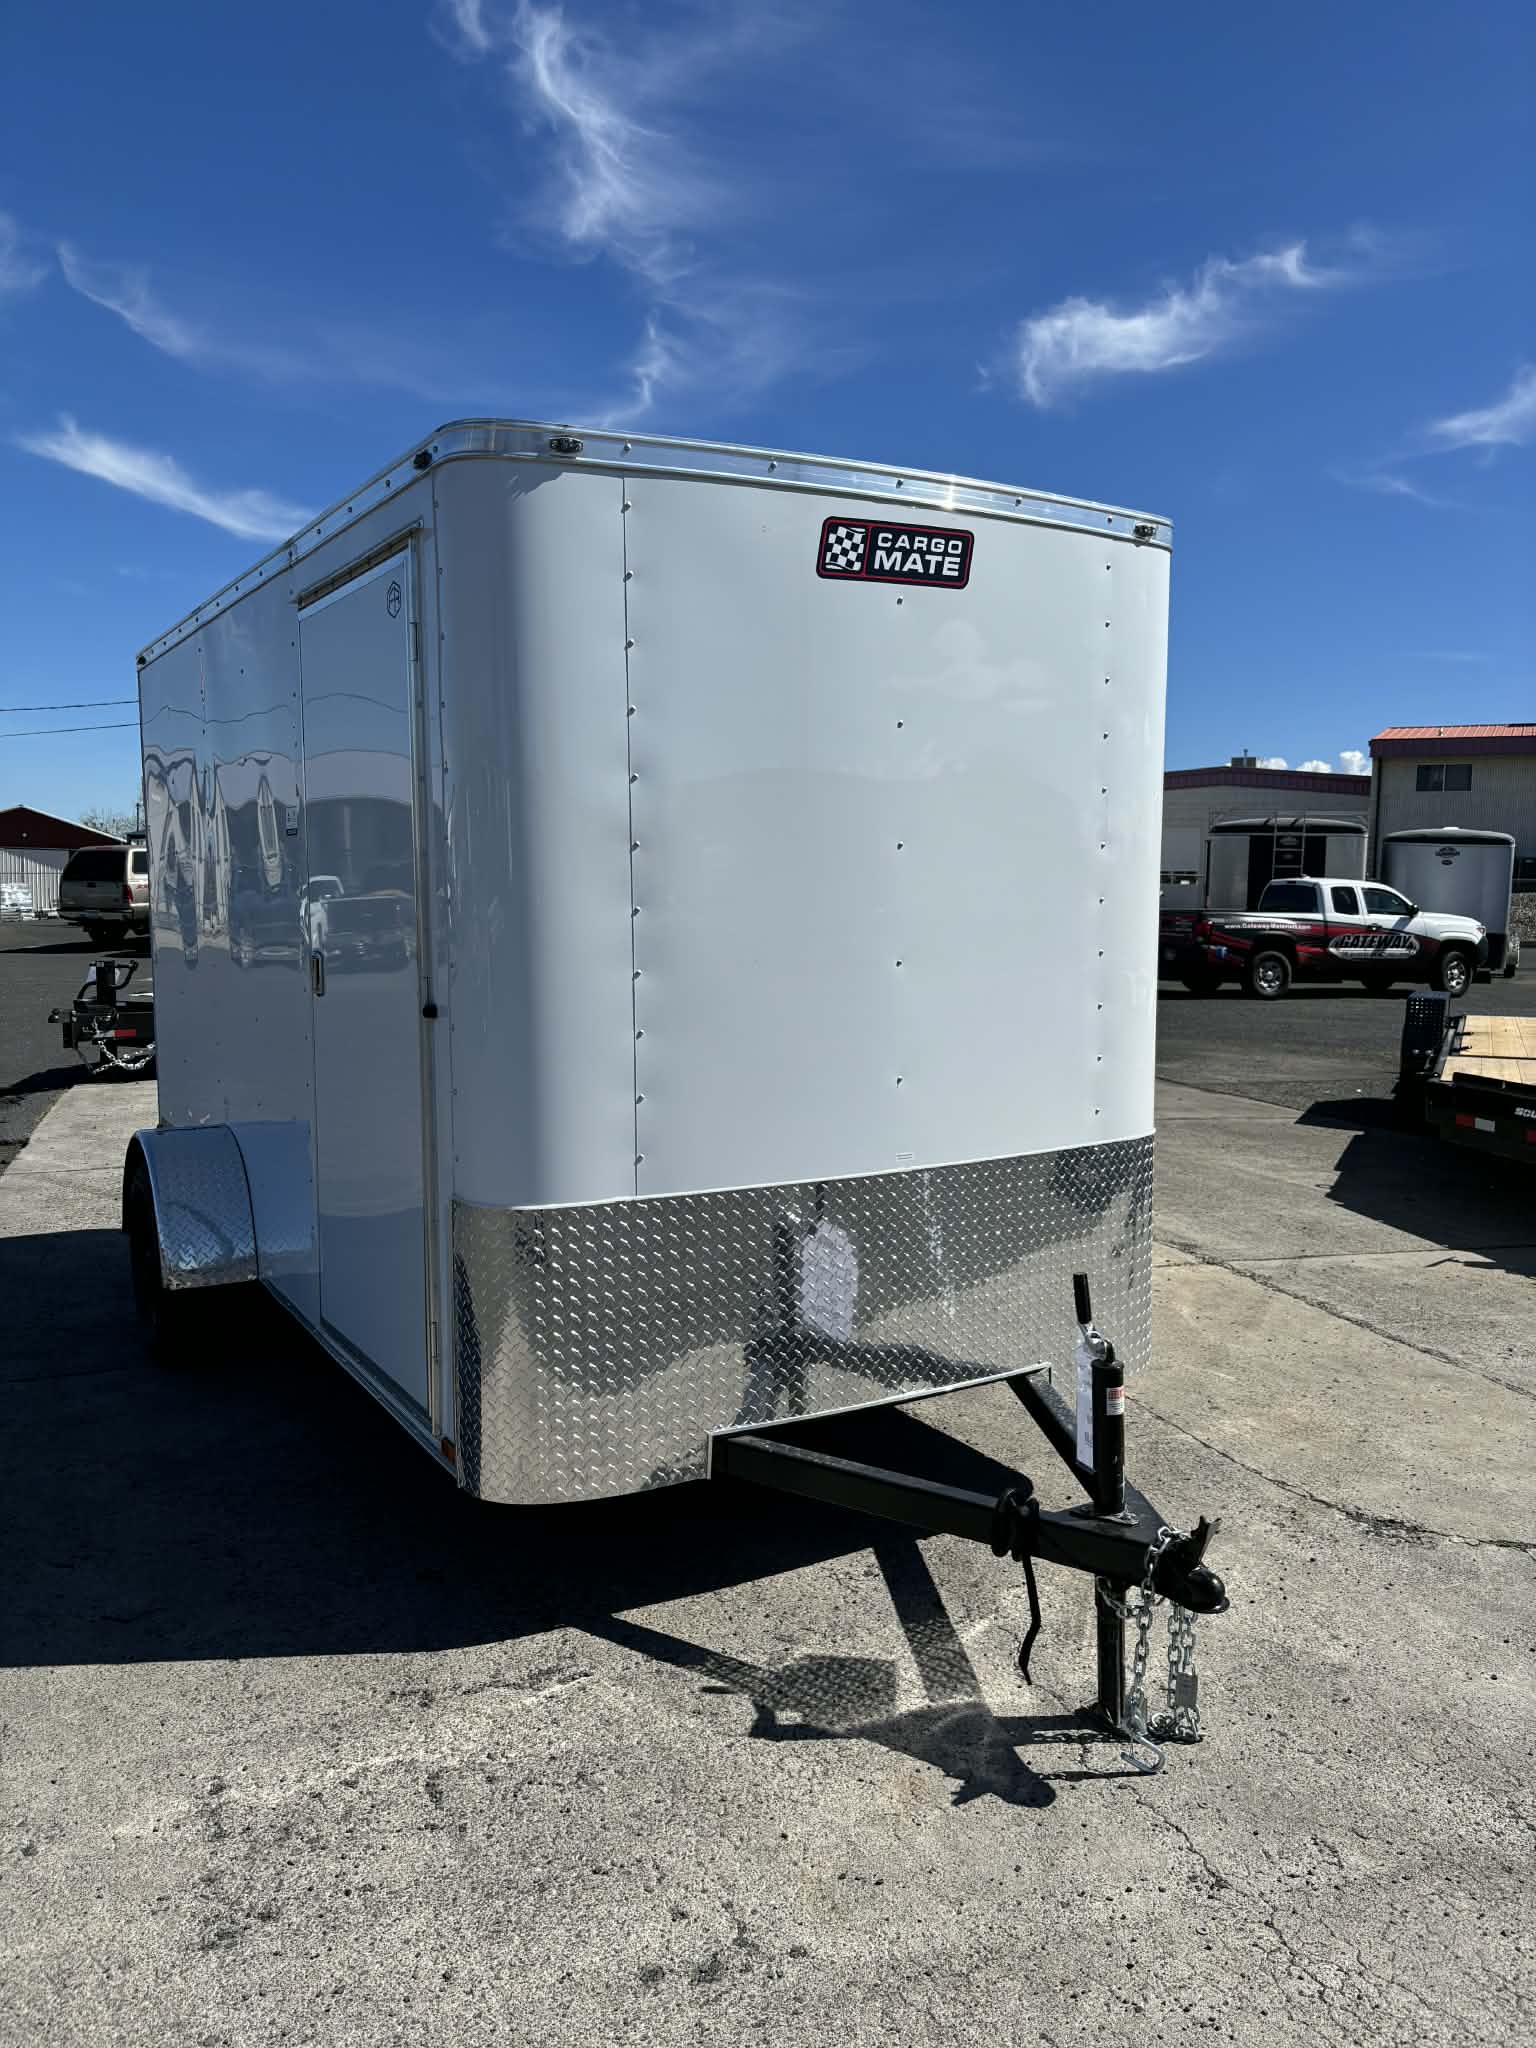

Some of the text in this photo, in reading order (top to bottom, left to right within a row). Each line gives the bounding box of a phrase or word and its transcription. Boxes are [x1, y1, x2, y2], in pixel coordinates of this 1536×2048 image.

[877, 532, 963, 555] CARGO
[873, 550, 962, 577] MATE
[1340, 935, 1412, 949] GATEWAY
